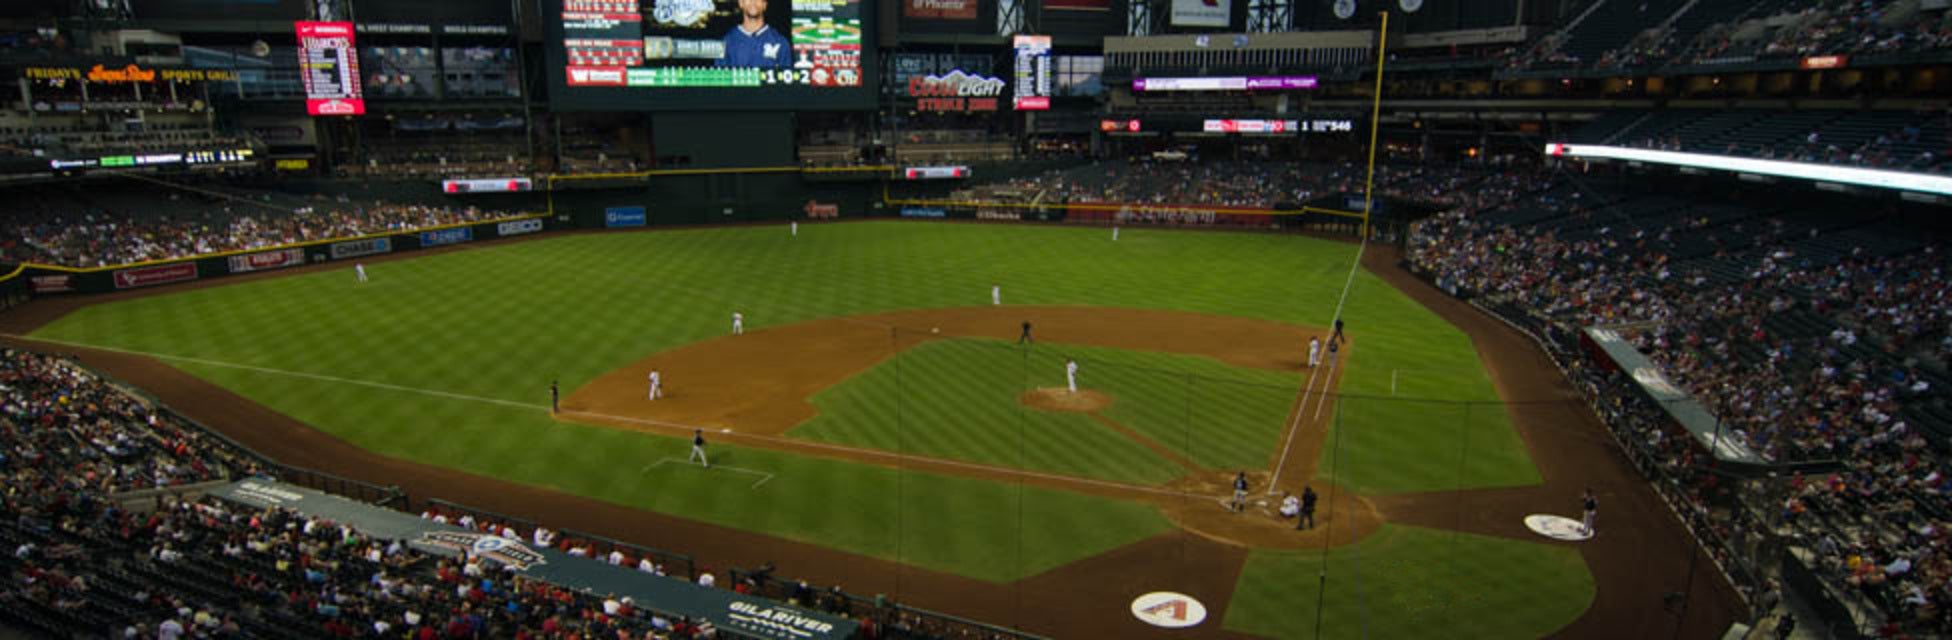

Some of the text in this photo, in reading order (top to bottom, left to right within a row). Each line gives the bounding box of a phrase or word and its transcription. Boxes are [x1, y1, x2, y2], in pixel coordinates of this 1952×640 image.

[161, 69, 204, 80] SPORTS
[766, 70, 777, 83] 1
[783, 70, 794, 83] 0
[800, 70, 810, 83] 2
[957, 80, 1004, 97] LIGHT
[498, 219, 543, 236] GEICO
[335, 239, 374, 253] CHASE
